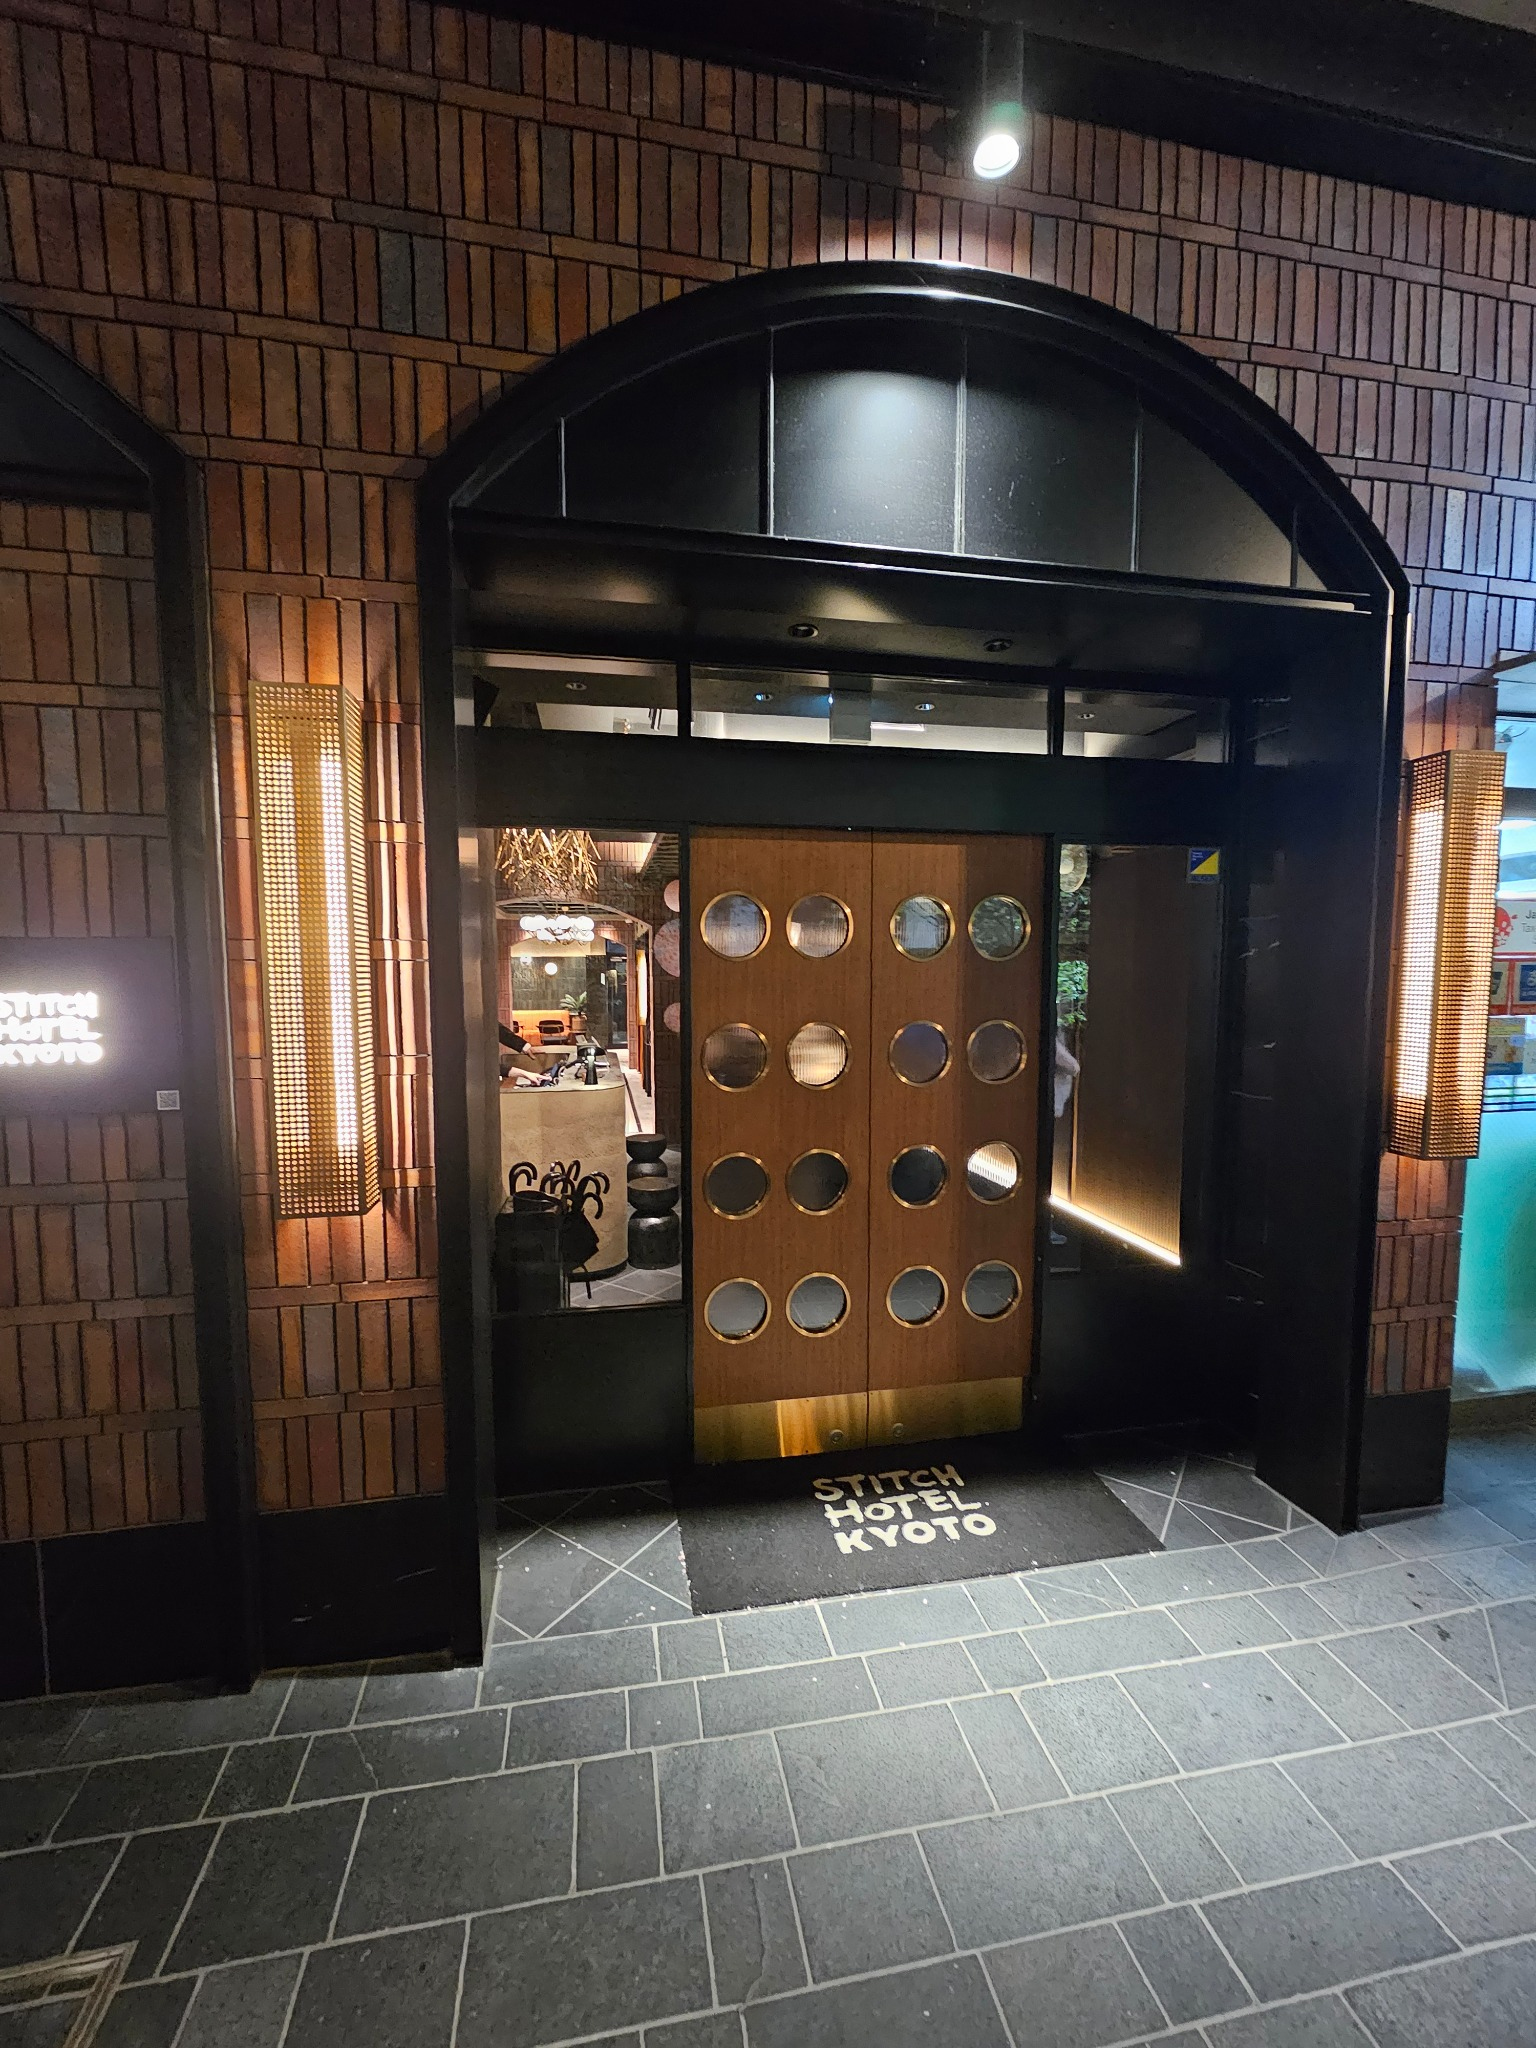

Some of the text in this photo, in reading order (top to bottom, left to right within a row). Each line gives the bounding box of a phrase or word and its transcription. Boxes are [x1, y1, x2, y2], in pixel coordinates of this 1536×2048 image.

[812, 1464, 965, 1501] STITCH
[824, 1490, 981, 1527] HOTEL
[834, 1513, 996, 1554] KYOTO
